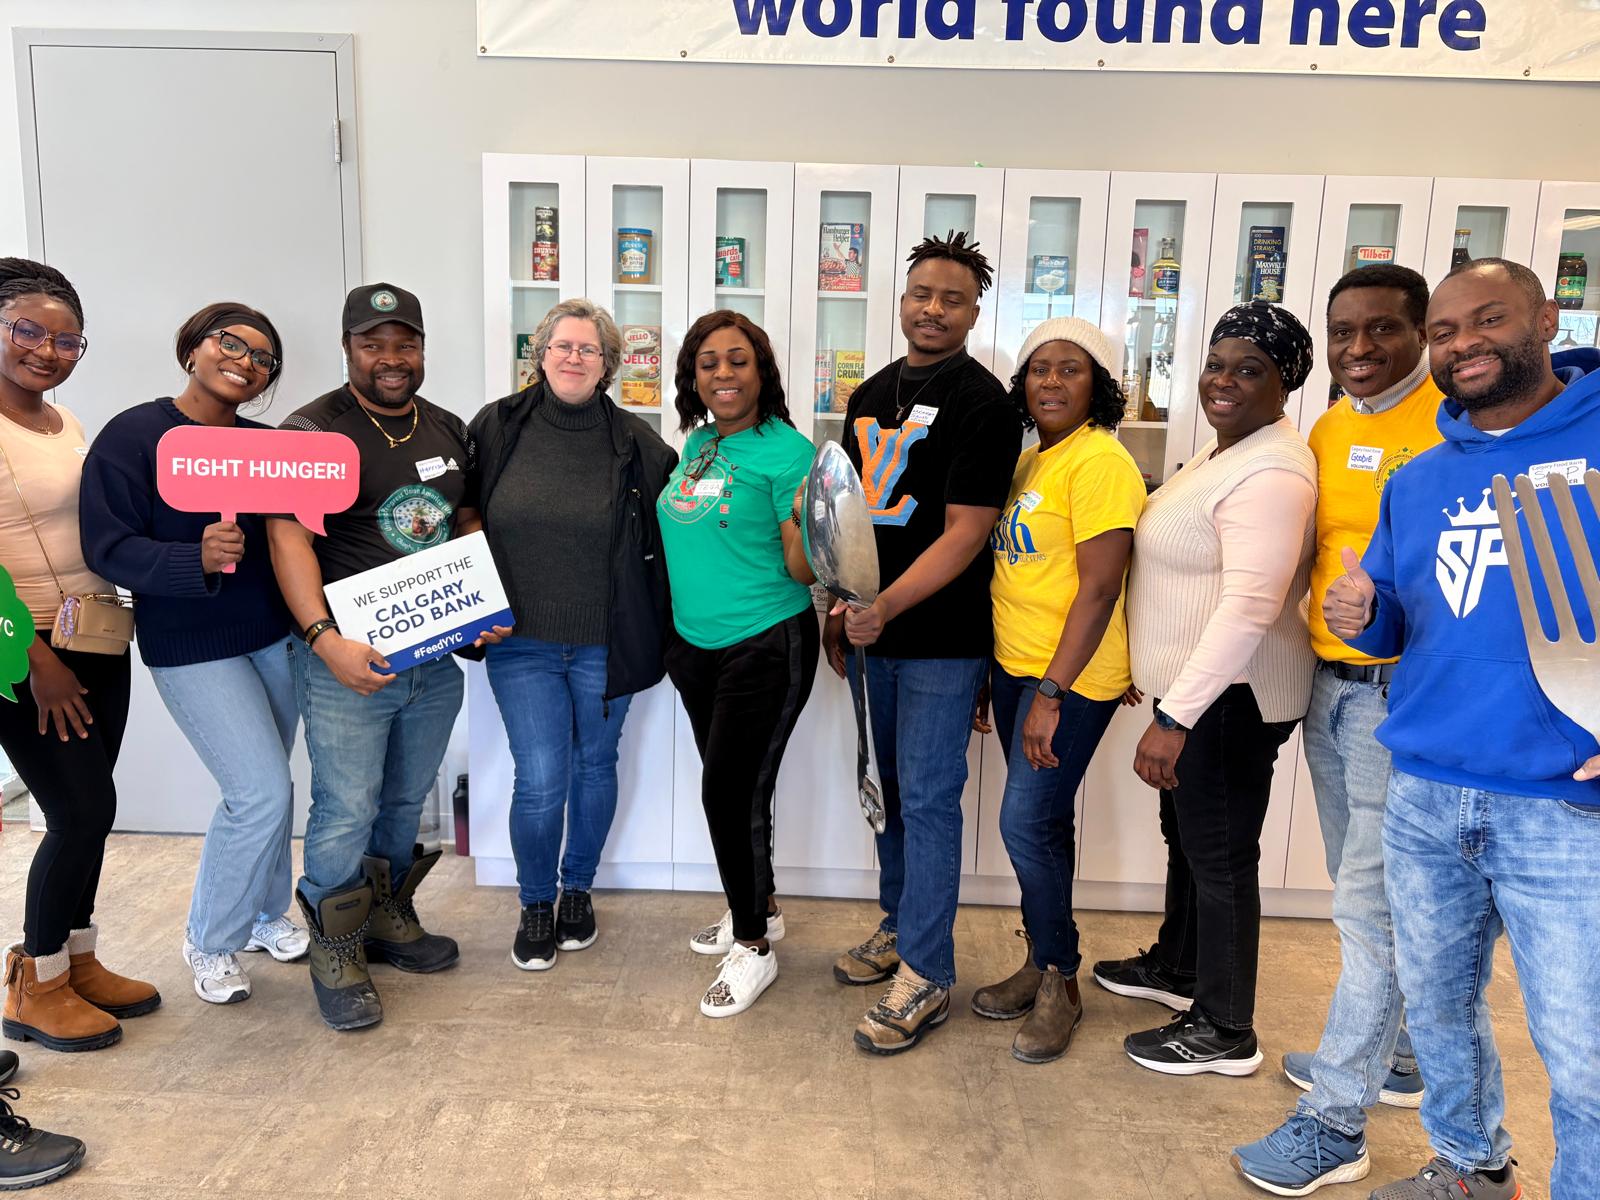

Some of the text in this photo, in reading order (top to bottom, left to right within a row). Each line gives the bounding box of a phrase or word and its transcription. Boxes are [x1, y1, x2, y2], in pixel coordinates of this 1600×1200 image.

[733, 0, 1487, 51] world found here
[1359, 248, 1392, 260] Tilbest
[623, 353, 660, 366] JELL-O
[837, 361, 853, 370] CORN
[172, 457, 346, 480] FIGHT HUNGER!
[353, 555, 475, 609] WE SUPPORT THE
[375, 579, 465, 623] CALGARY
[366, 590, 486, 646] FOOD BANK
[413, 632, 464, 660] #FeedYYC
